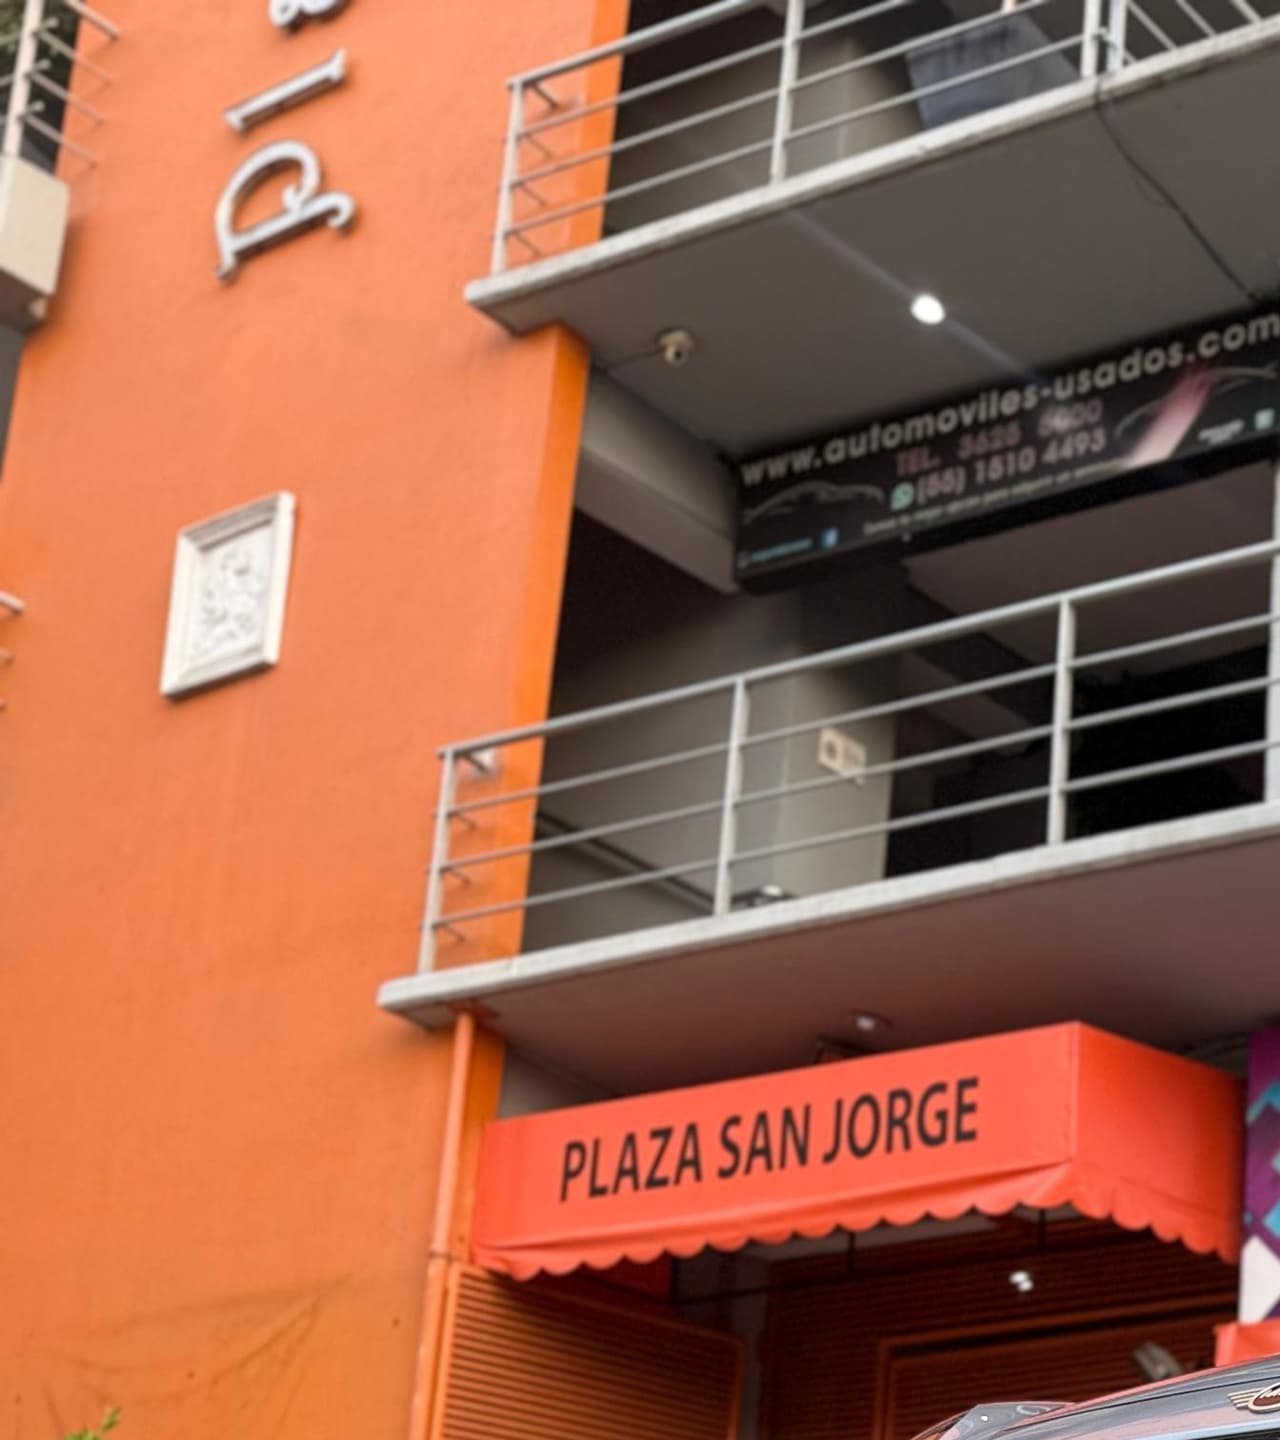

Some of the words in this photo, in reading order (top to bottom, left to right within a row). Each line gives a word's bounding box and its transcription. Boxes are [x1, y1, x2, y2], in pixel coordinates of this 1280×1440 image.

[214, 0, 355, 281] Pl
[560, 1121, 703, 1203] PLAZA
[717, 1104, 812, 1180] SAN
[823, 1076, 980, 1163] JORGE
